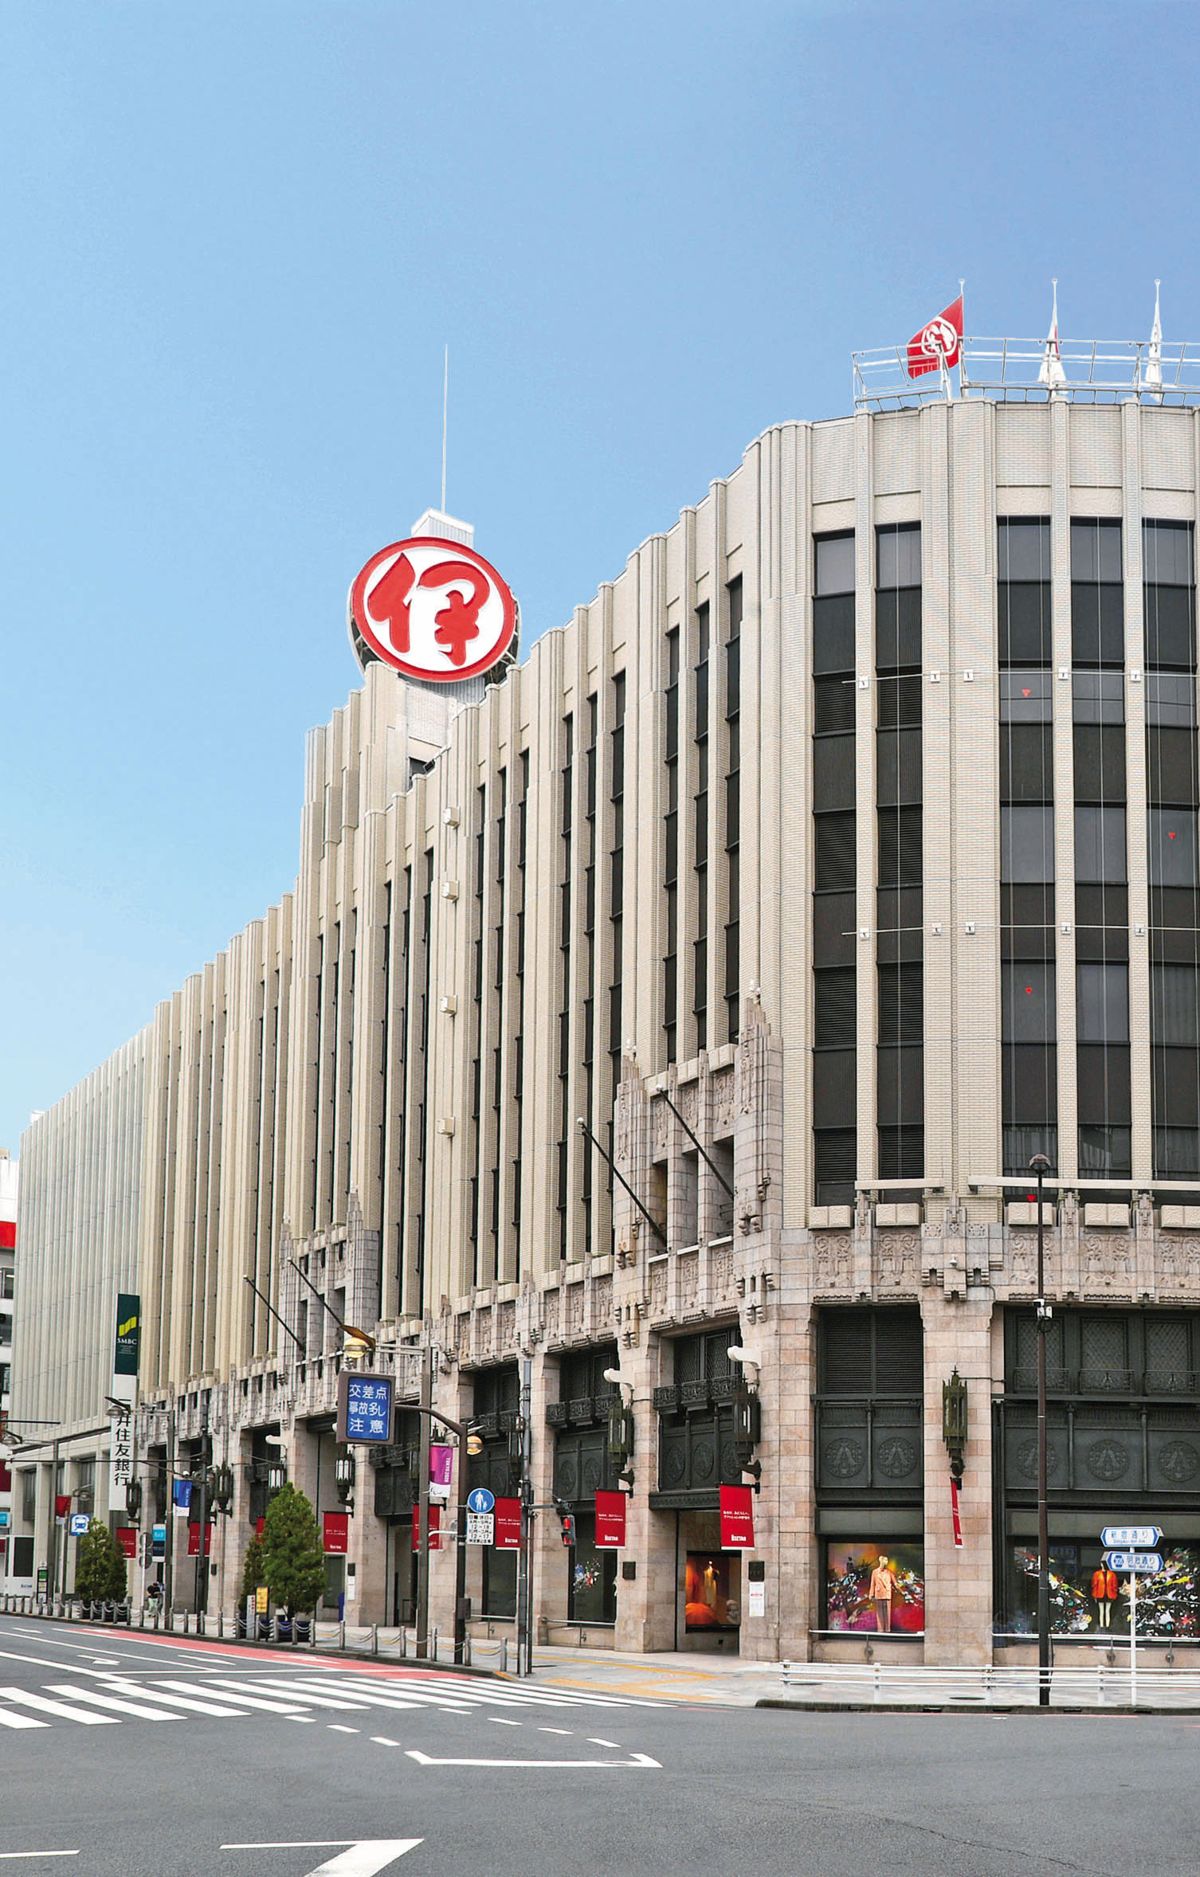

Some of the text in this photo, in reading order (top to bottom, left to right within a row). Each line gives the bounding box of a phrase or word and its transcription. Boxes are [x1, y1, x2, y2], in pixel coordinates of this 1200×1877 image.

[349, 1384, 387, 1400] 交差点
[349, 1401, 386, 1417] 事故多し
[350, 1418, 384, 1433] 注意
